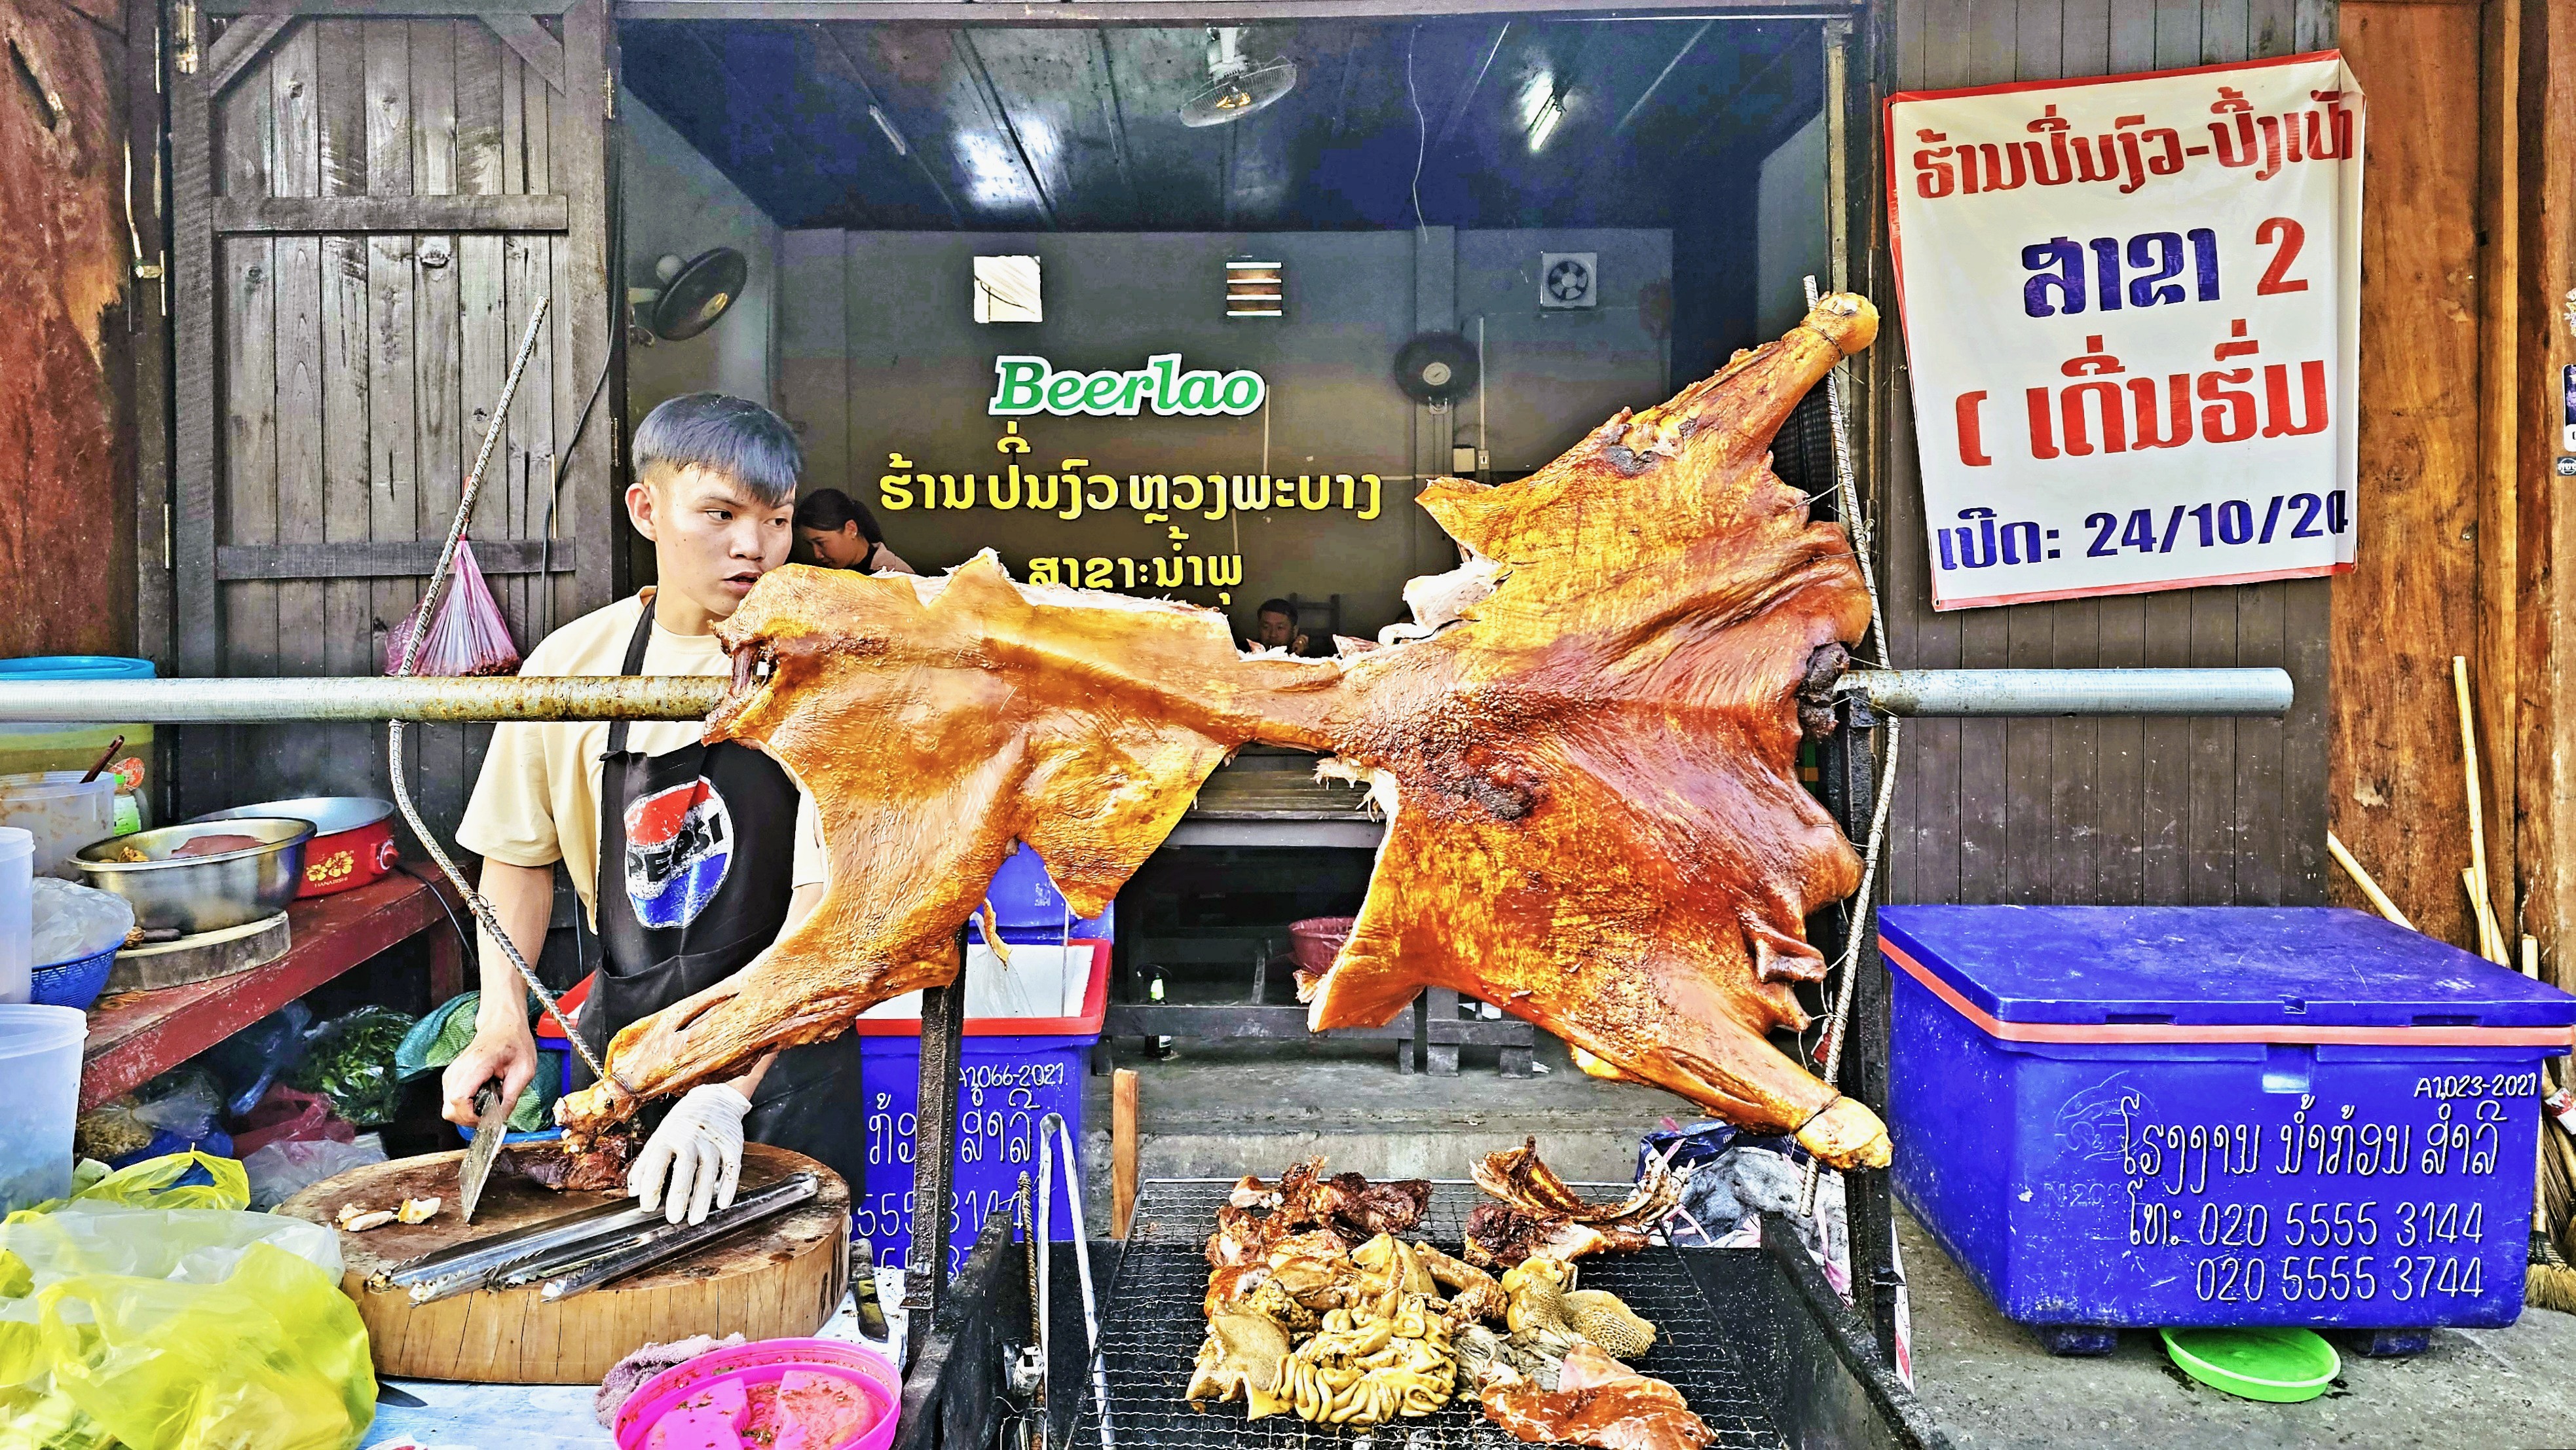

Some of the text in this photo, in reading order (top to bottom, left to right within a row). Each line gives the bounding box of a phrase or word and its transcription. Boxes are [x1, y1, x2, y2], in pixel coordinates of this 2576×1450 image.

[2021, 217, 2308, 318] ສາຂາ 2
[988, 353, 1265, 417] Beerlao
[880, 453, 975, 510] ຮ້ານ
[1129, 474, 1381, 523] ຫຼວງພະບາງ
[1937, 507, 2062, 570] ເປີດ:
[961, 1088, 1041, 1164] ສຳລີ
[2120, 1093, 2261, 1195] ໂຮງງານ
[2421, 1100, 2508, 1176] ສຳລີ
[2127, 1177, 2484, 1247] ໂທ: 020 5555 3144
[2195, 1255, 2484, 1301] 020 5555 3744
